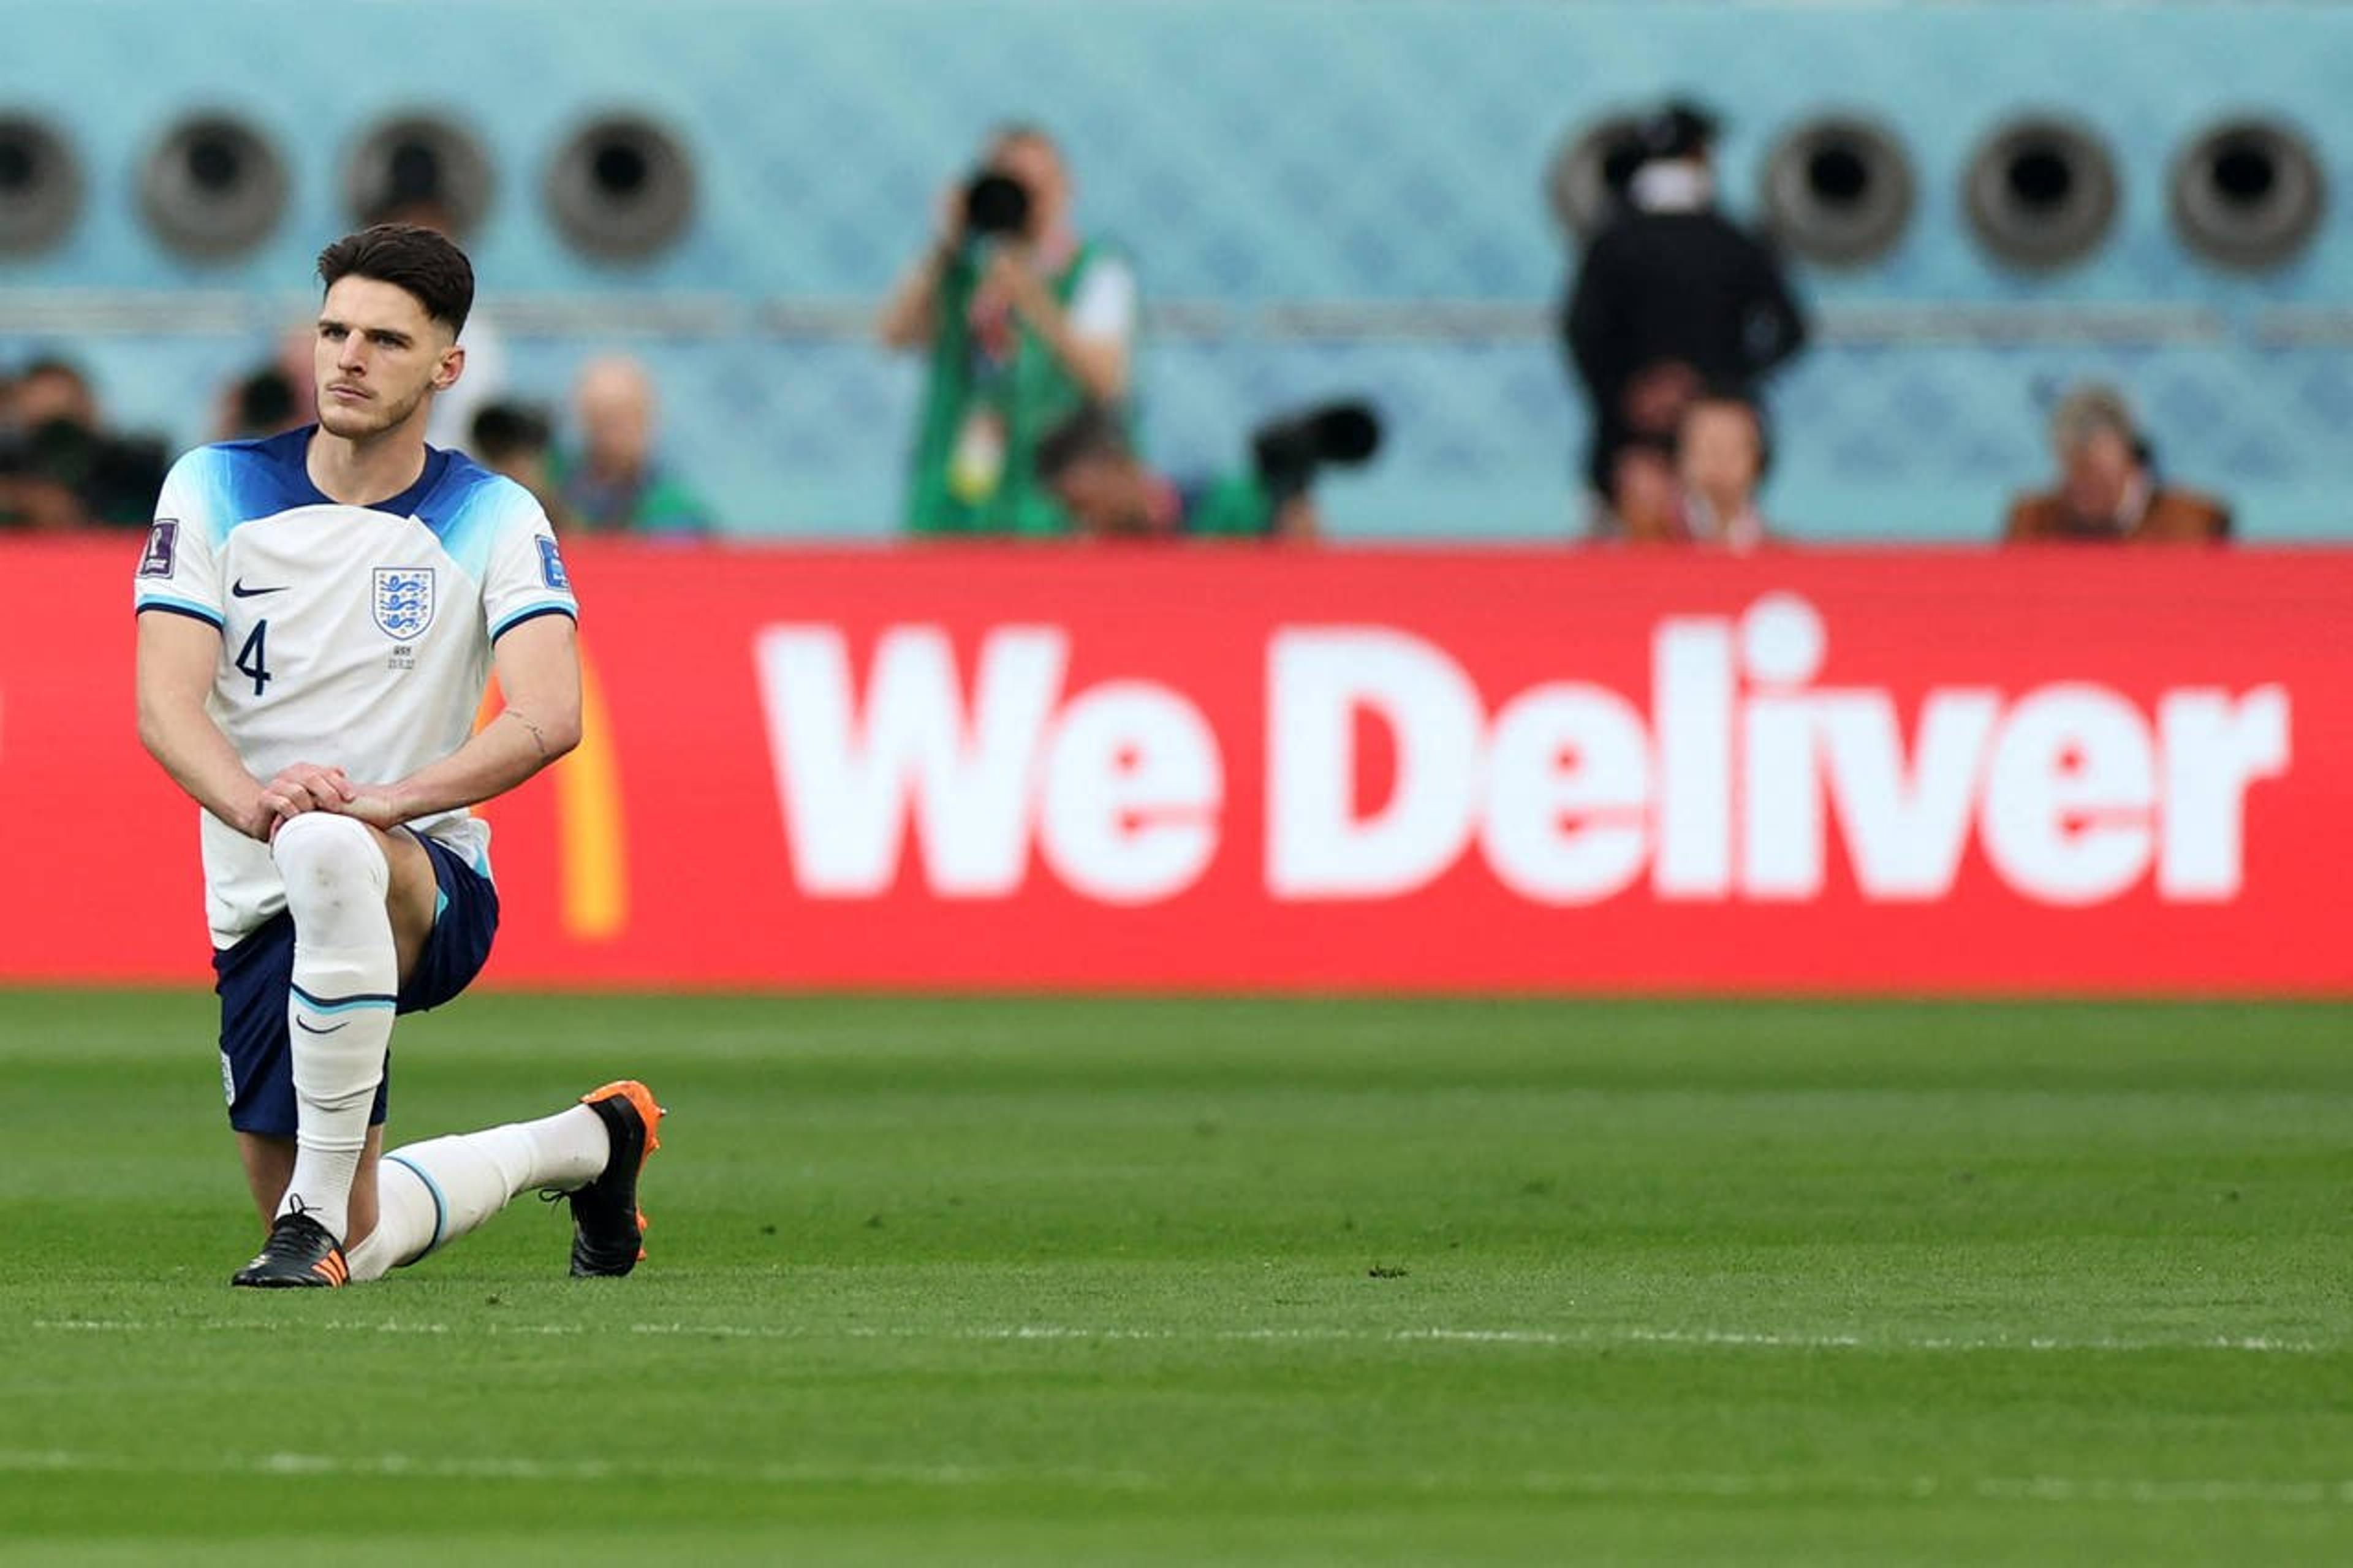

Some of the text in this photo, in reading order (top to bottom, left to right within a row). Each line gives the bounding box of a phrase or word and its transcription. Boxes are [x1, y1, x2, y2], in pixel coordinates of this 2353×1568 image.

[235, 619, 271, 696] 4
[756, 596, 2290, 903] We Deliver
